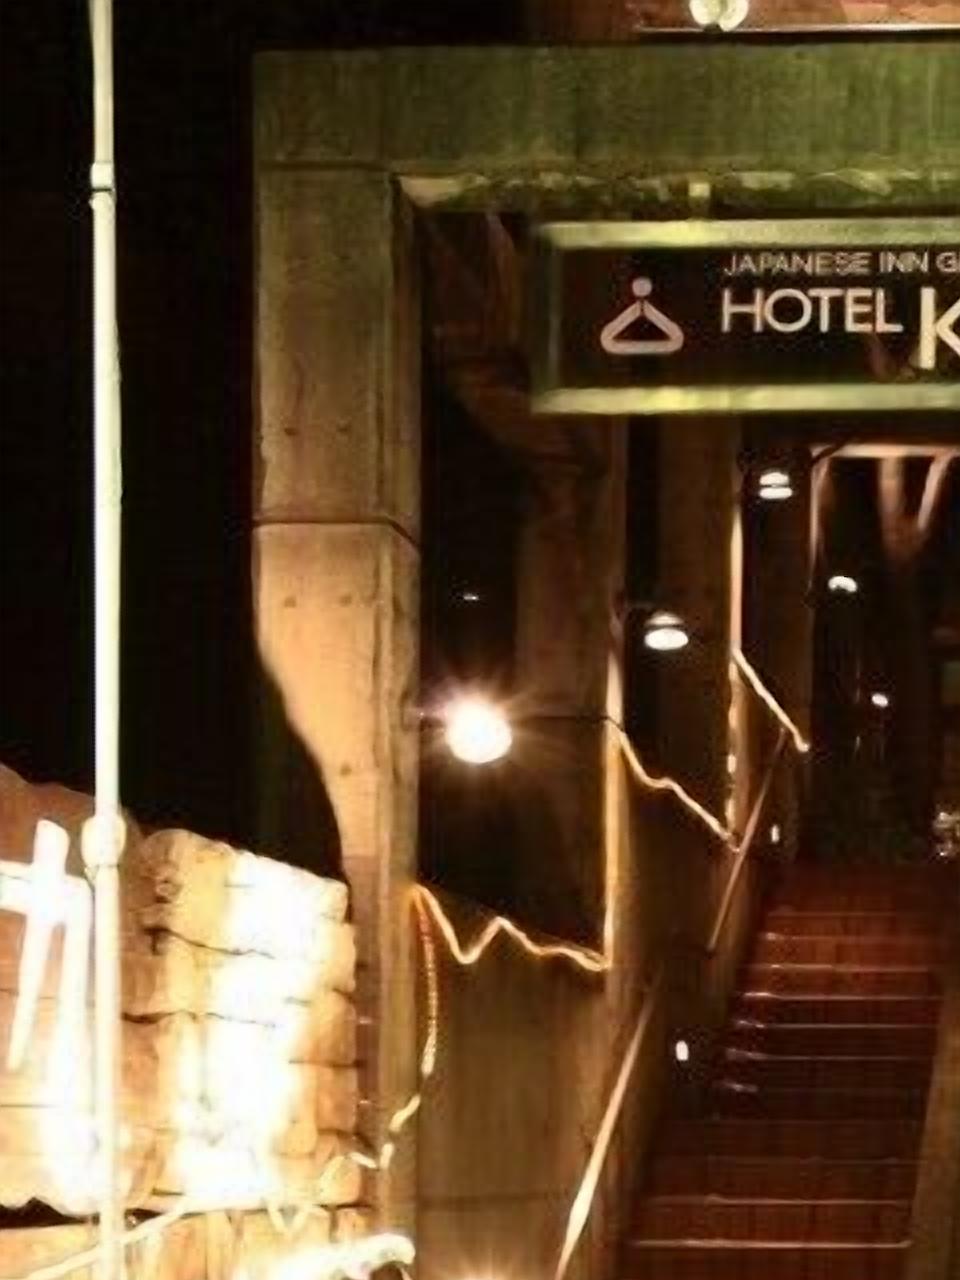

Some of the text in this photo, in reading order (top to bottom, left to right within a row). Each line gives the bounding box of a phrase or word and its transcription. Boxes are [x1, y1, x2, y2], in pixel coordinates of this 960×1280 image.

[724, 251, 873, 276] JAPANESE
[879, 250, 929, 274] INN
[721, 286, 904, 334] HOTEL
